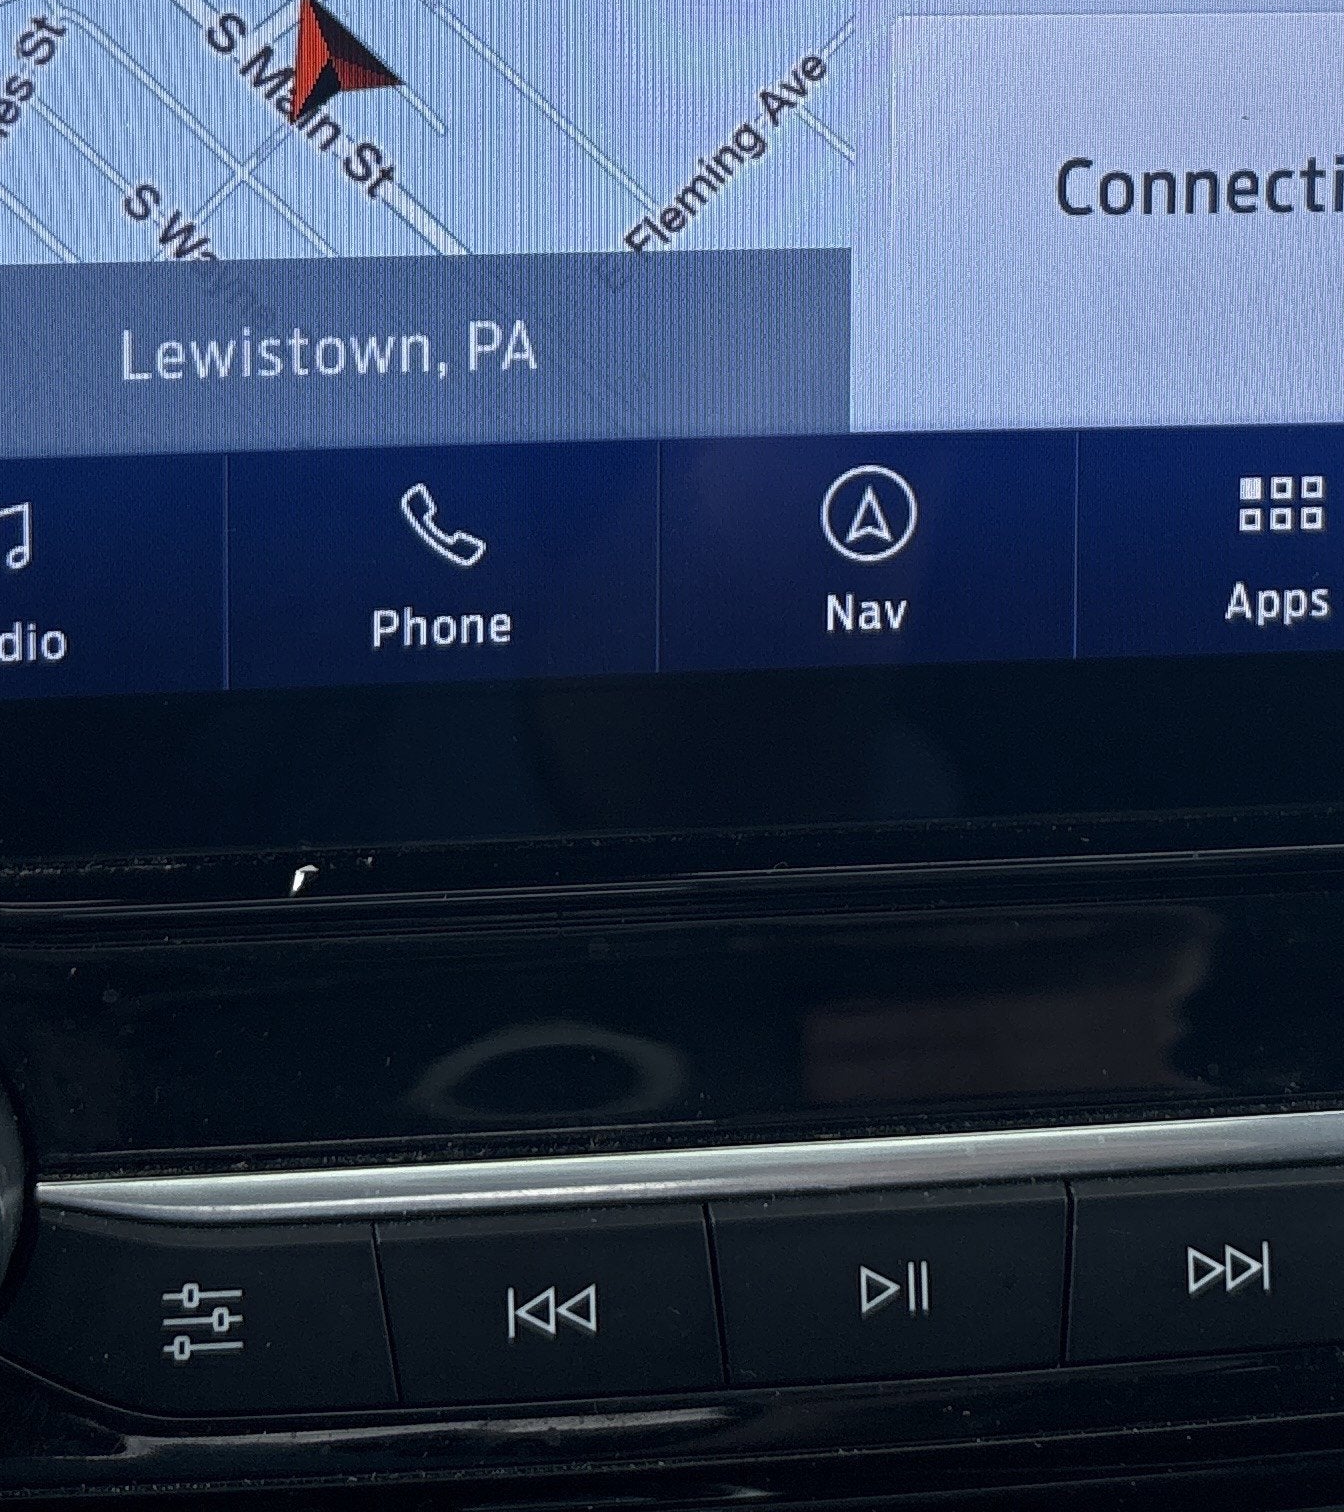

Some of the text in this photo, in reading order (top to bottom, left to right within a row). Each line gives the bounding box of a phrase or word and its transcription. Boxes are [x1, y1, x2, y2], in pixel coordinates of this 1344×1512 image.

[16, 14, 68, 66] St
[207, 13, 247, 54] S
[344, 142, 396, 200] St
[623, 120, 768, 258] Fleming
[759, 52, 829, 128] Ave
[124, 184, 161, 221] S
[121, 319, 539, 382] Lewistown, PA
[371, 606, 513, 650] Phone
[825, 592, 909, 633] Nav
[1223, 580, 1331, 627] Apps
